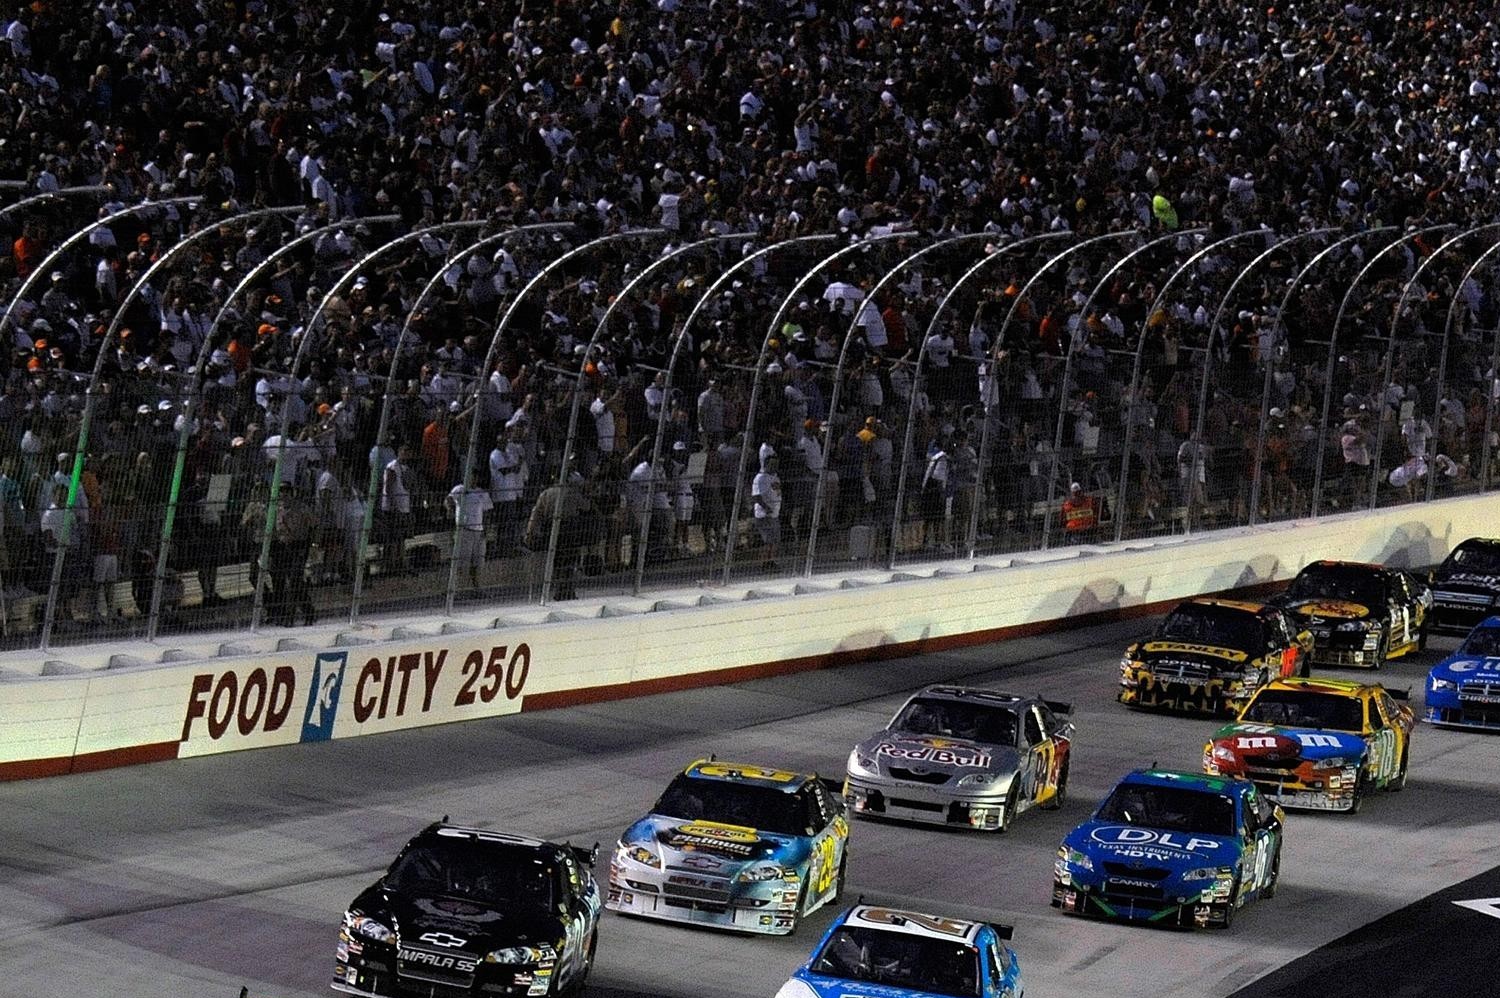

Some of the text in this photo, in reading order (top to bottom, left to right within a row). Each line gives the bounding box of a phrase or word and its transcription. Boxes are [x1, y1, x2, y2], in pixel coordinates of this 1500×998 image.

[1151, 643, 1240, 659] STANLEY
[180, 642, 531, 743] FOOD CITY 250
[1236, 736, 1278, 750] m
[1296, 733, 1344, 749] m
[875, 742, 992, 769] Red Bull
[672, 833, 752, 853] Platinum
[1117, 828, 1220, 851] DLP
[1108, 877, 1159, 889] CAMRY
[397, 949, 477, 973] IMPALA SS
